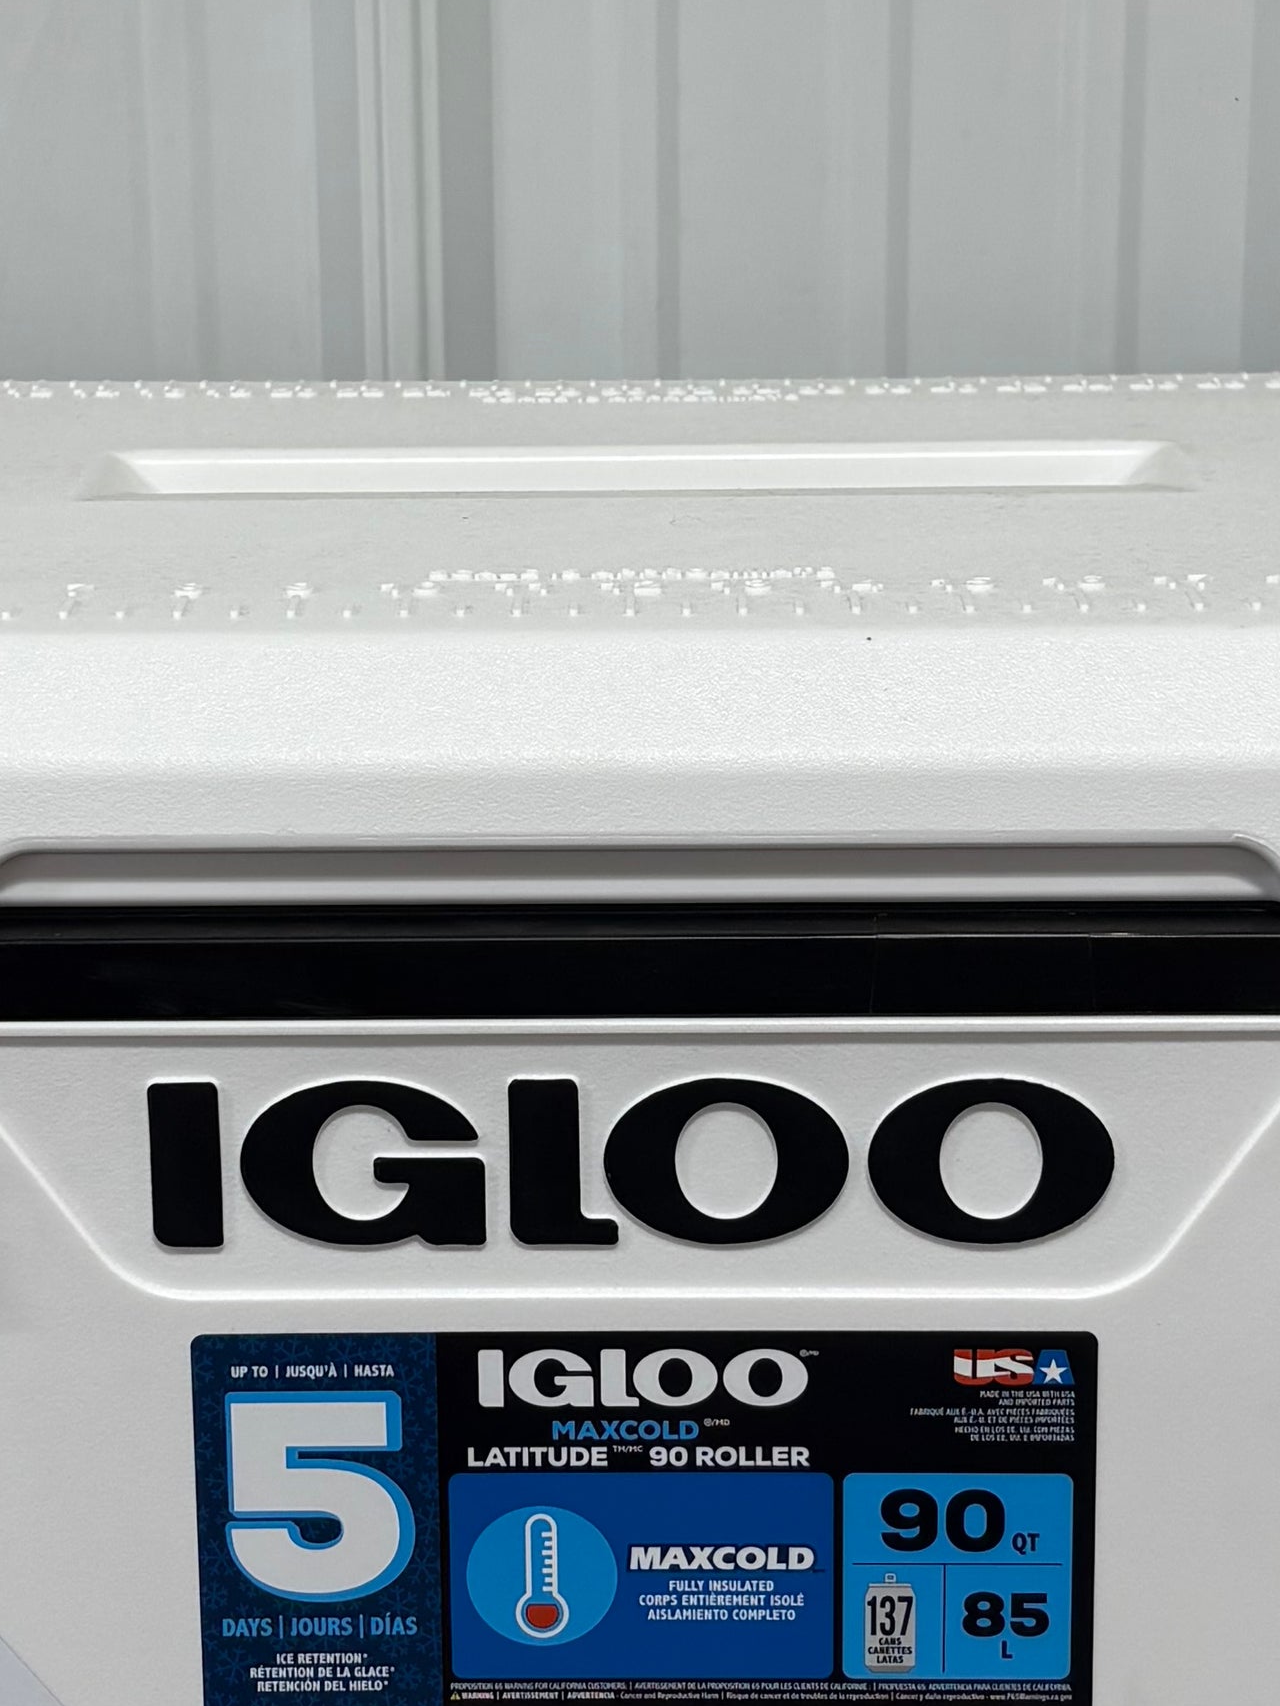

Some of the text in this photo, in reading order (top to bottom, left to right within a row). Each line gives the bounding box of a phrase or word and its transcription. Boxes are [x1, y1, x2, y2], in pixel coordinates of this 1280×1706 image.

[147, 1076, 1115, 1248] IGLOO
[230, 1365, 268, 1378] UP TO
[354, 1364, 394, 1377] HASTA
[477, 1348, 808, 1408] IGLOO
[953, 1349, 1076, 1386] USA
[552, 1420, 699, 1440] MAXCOLD
[467, 1447, 608, 1468] LATITUDE
[649, 1446, 810, 1467] 90 ROLLER
[225, 1390, 416, 1603] 5
[879, 1488, 1040, 1555] 90 QT
[629, 1546, 815, 1571] MAXCOLD
[669, 1581, 774, 1592] FULLY INSULATED
[639, 1592, 804, 1606] CORPS ENTIÈREMENT ISOLÉ
[370, 1612, 418, 1635] DÍAS
[647, 1609, 796, 1621] AISLAMIENTO COMPLETO
[866, 1595, 914, 1637] 137
[961, 1591, 1050, 1638] 85
[222, 1618, 273, 1638] DAYS
[290, 1616, 353, 1637] JOURS
[276, 1653, 296, 1665] ICE
[876, 1655, 904, 1665] LATAS
[1000, 1641, 1013, 1660] L
